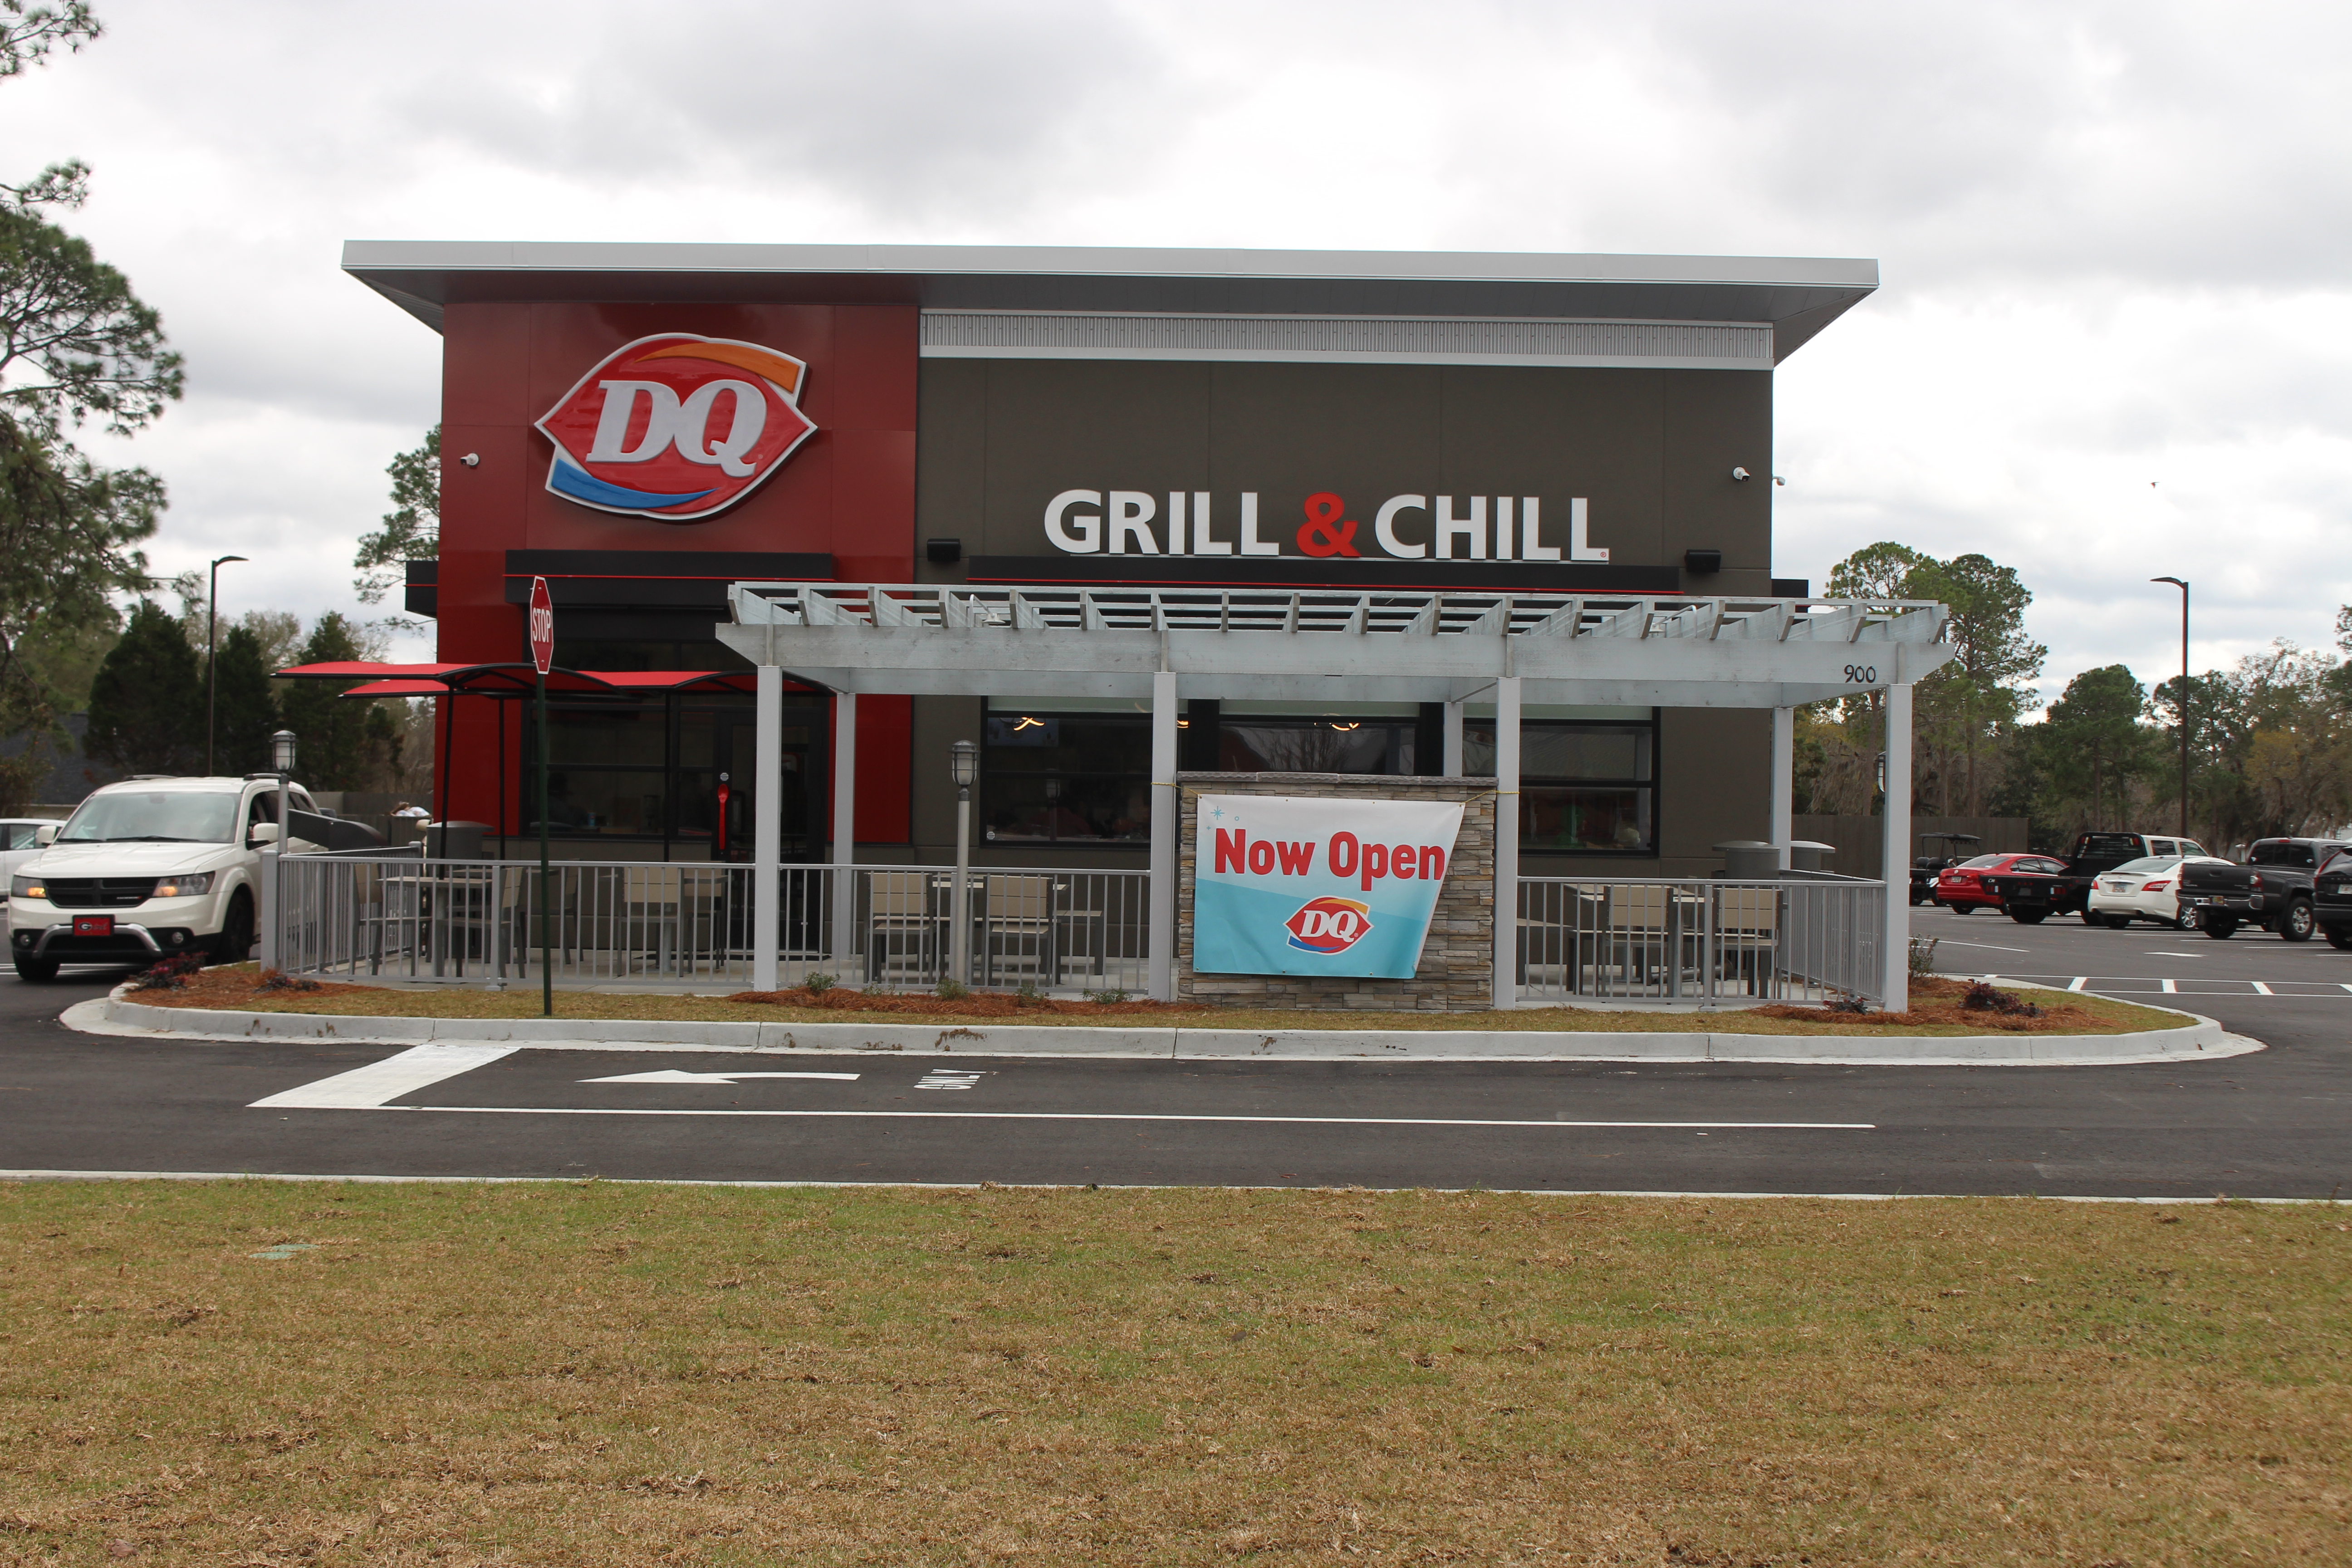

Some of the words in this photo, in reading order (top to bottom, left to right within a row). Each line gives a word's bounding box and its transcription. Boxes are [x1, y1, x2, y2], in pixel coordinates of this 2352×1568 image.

[585, 379, 757, 478] DQ
[1044, 489, 1279, 556] GRILL
[1296, 491, 1361, 558] &
[1375, 494, 1610, 561] CHILL
[533, 607, 551, 643] STOP
[1844, 664, 1876, 683] 900
[1214, 828, 1316, 876] Now
[1328, 831, 1446, 892] Open
[1299, 909, 1359, 942] DQ
[913, 1068, 987, 1090] ONLY
